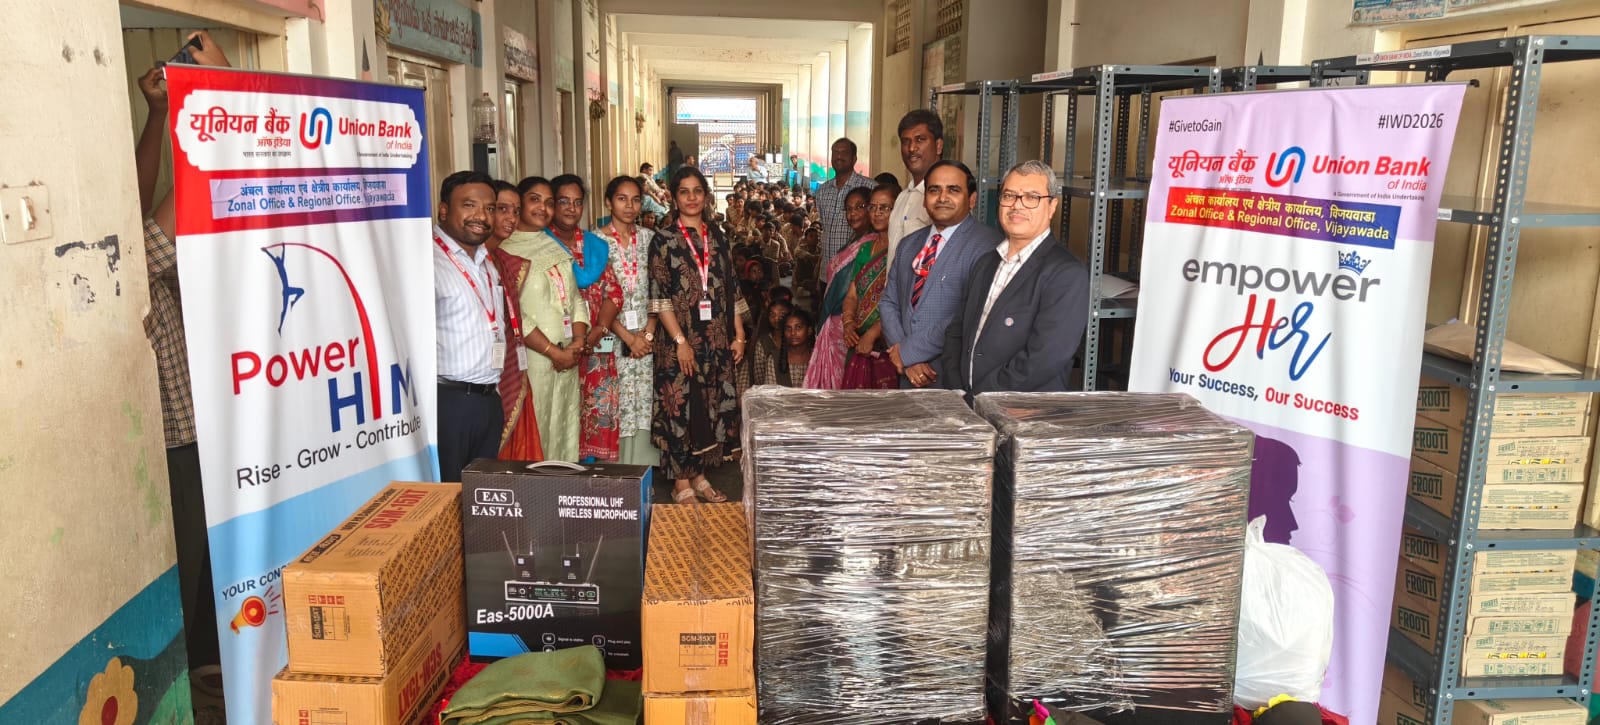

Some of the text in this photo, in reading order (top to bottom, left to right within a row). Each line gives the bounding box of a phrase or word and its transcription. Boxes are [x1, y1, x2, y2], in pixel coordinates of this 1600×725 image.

[190, 106, 291, 141] यूनियन बैंक
[338, 117, 412, 139] Union Bank
[1168, 119, 1222, 133] #GivetoGain
[1377, 113, 1444, 130] #IWD2026
[386, 140, 413, 151] of India
[1168, 149, 1258, 178] यूनियन बैंक
[1312, 155, 1431, 177] Union Bank
[1387, 179, 1427, 191] of India
[228, 199, 256, 212] Zonal
[259, 198, 286, 210] Office
[288, 197, 295, 208] &
[298, 194, 334, 209] Regional
[1185, 193, 1205, 206] अंचल
[1208, 193, 1239, 208] कार्यालय
[1242, 196, 1254, 210] एवं
[1257, 195, 1281, 213] क्षेत्रीय
[1170, 205, 1389, 240] Zonal Office & Regional Office, Vijayawada
[1182, 258, 1381, 302] empower
[1202, 293, 1332, 381] Her
[231, 336, 360, 395] Power
[1168, 367, 1360, 421] Your Success, Our Success
[236, 463, 281, 490] Rise
[297, 443, 341, 470] Grow
[356, 415, 421, 450] Contribute
[1414, 430, 1449, 453] FROOTI
[1411, 475, 1443, 496] FROOTI
[482, 492, 507, 503] EAS
[558, 495, 624, 507] PROFESSIONAL UHF
[364, 489, 429, 529] SCM-15XT
[471, 506, 524, 518] EASTAR
[558, 508, 638, 521] WIRELESS MICROPHONE
[1404, 535, 1440, 559] FROOTI
[222, 579, 257, 600] YOUR
[1405, 572, 1437, 598] FROOTI
[476, 603, 555, 624] Eas-5000A
[1398, 609, 1431, 637] FROOTI
